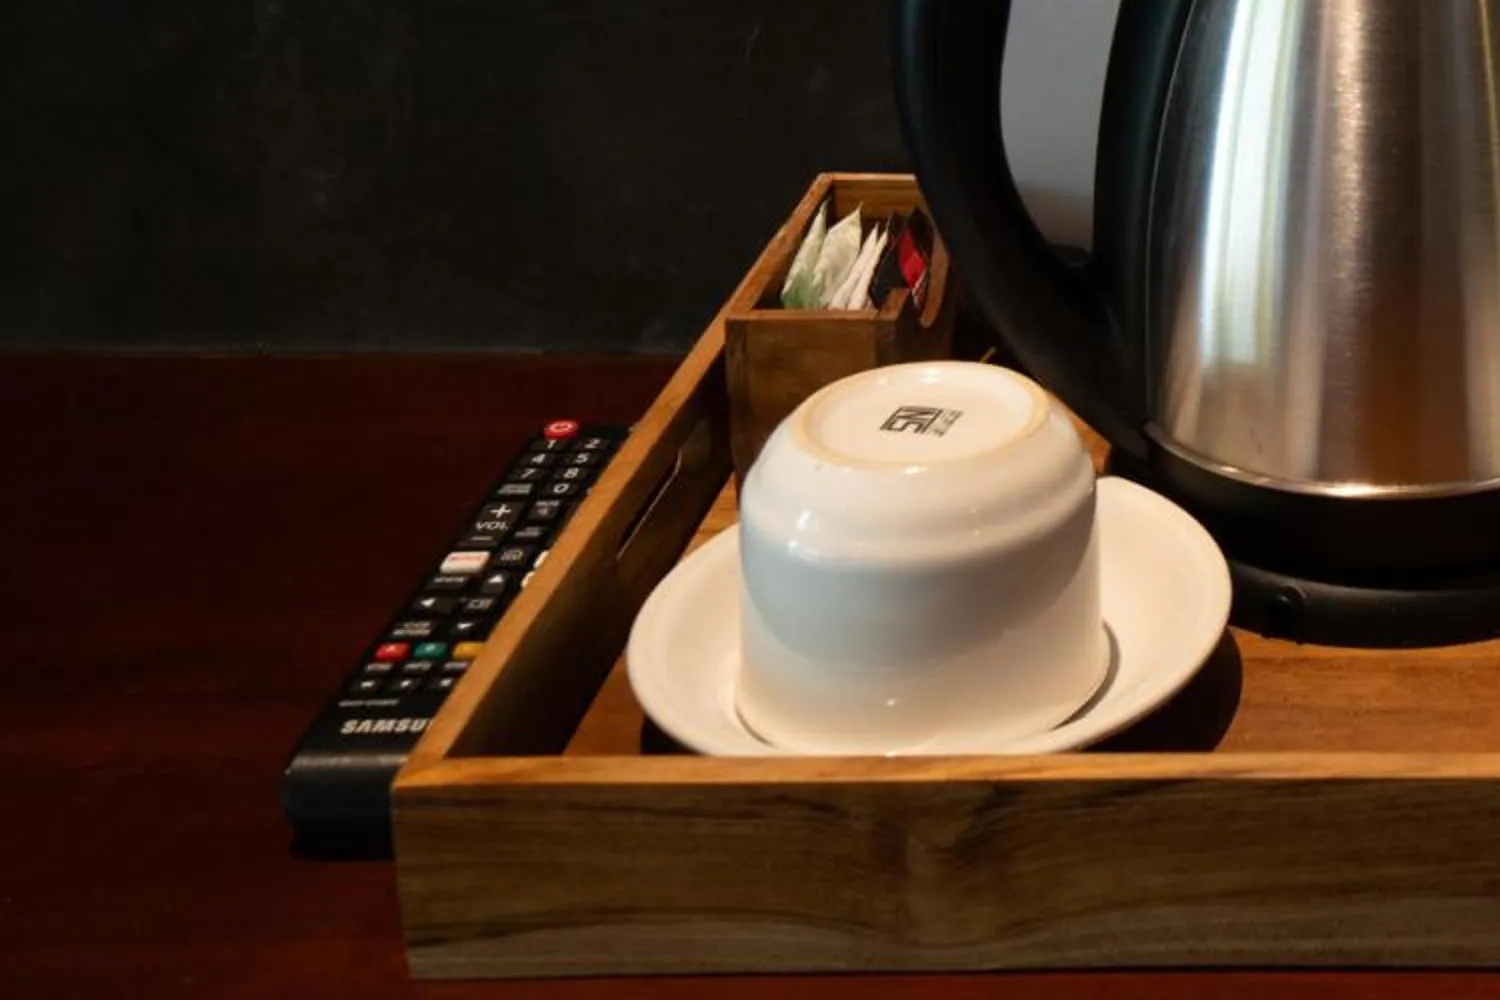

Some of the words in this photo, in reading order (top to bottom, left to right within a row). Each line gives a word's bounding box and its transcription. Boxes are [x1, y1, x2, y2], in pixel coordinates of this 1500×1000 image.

[547, 439, 557, 449] 1
[584, 437, 601, 449] 2
[531, 453, 547, 464] 4
[574, 452, 591, 464] 5
[521, 467, 537, 479] 7
[563, 467, 579, 479] 8
[553, 482, 571, 494] 0
[340, 718, 433, 735] SAMSU
